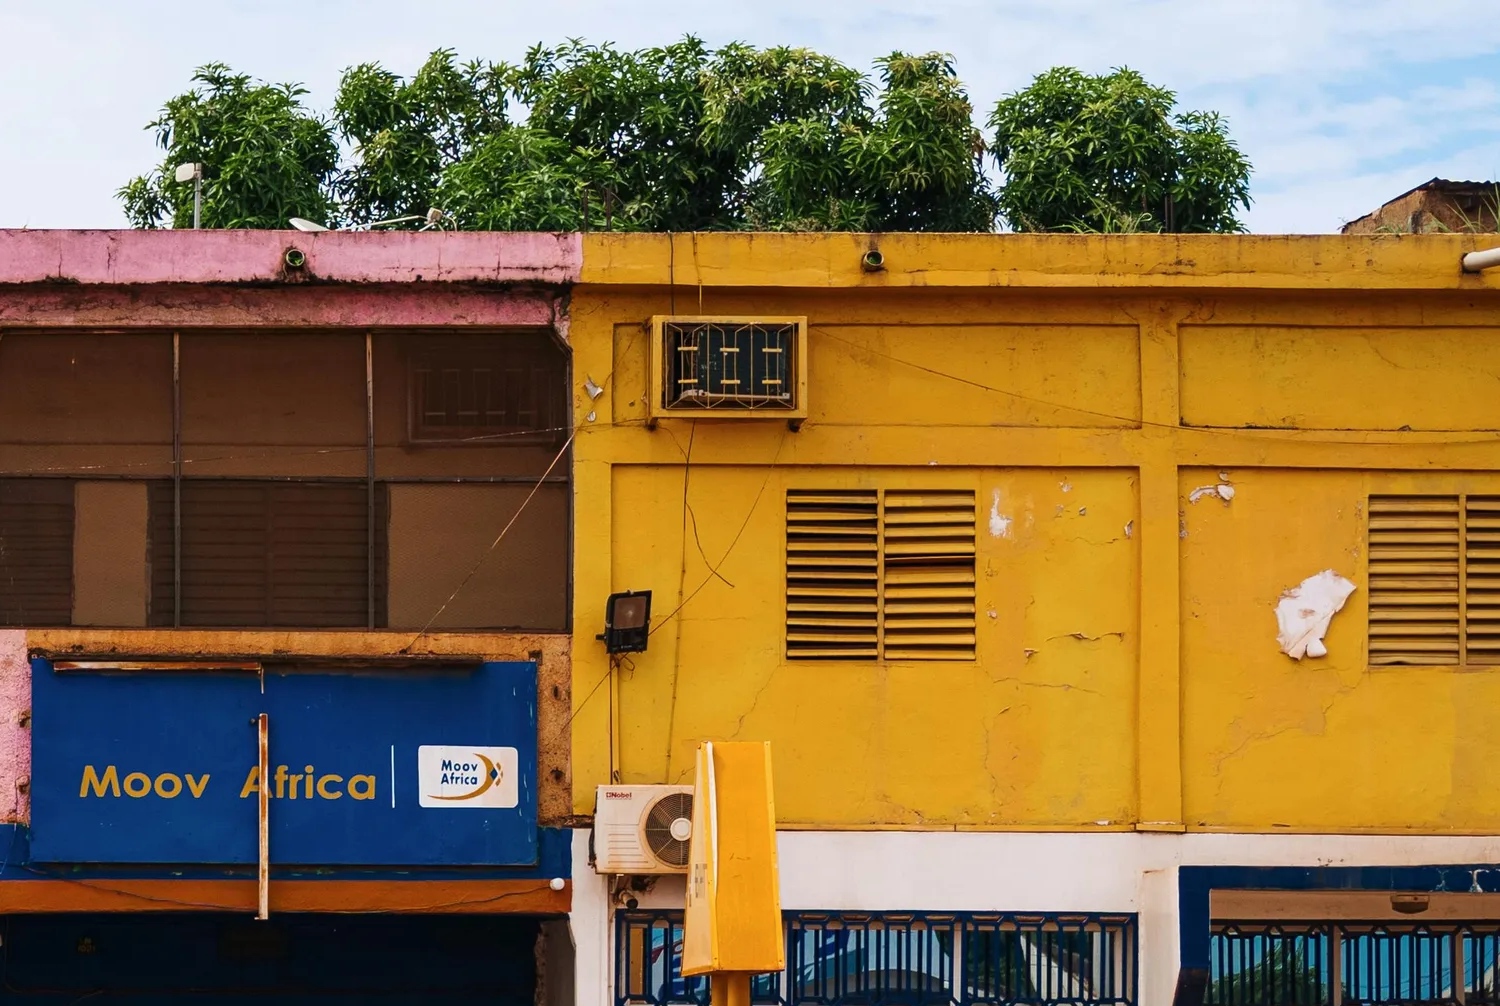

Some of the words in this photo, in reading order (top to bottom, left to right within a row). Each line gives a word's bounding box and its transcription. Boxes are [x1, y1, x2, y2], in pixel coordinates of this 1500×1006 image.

[441, 759, 478, 772] Moov
[80, 765, 210, 799] Moov
[240, 764, 376, 801] Africa
[441, 772, 478, 786] Africa
[611, 791, 632, 799] Nobel
